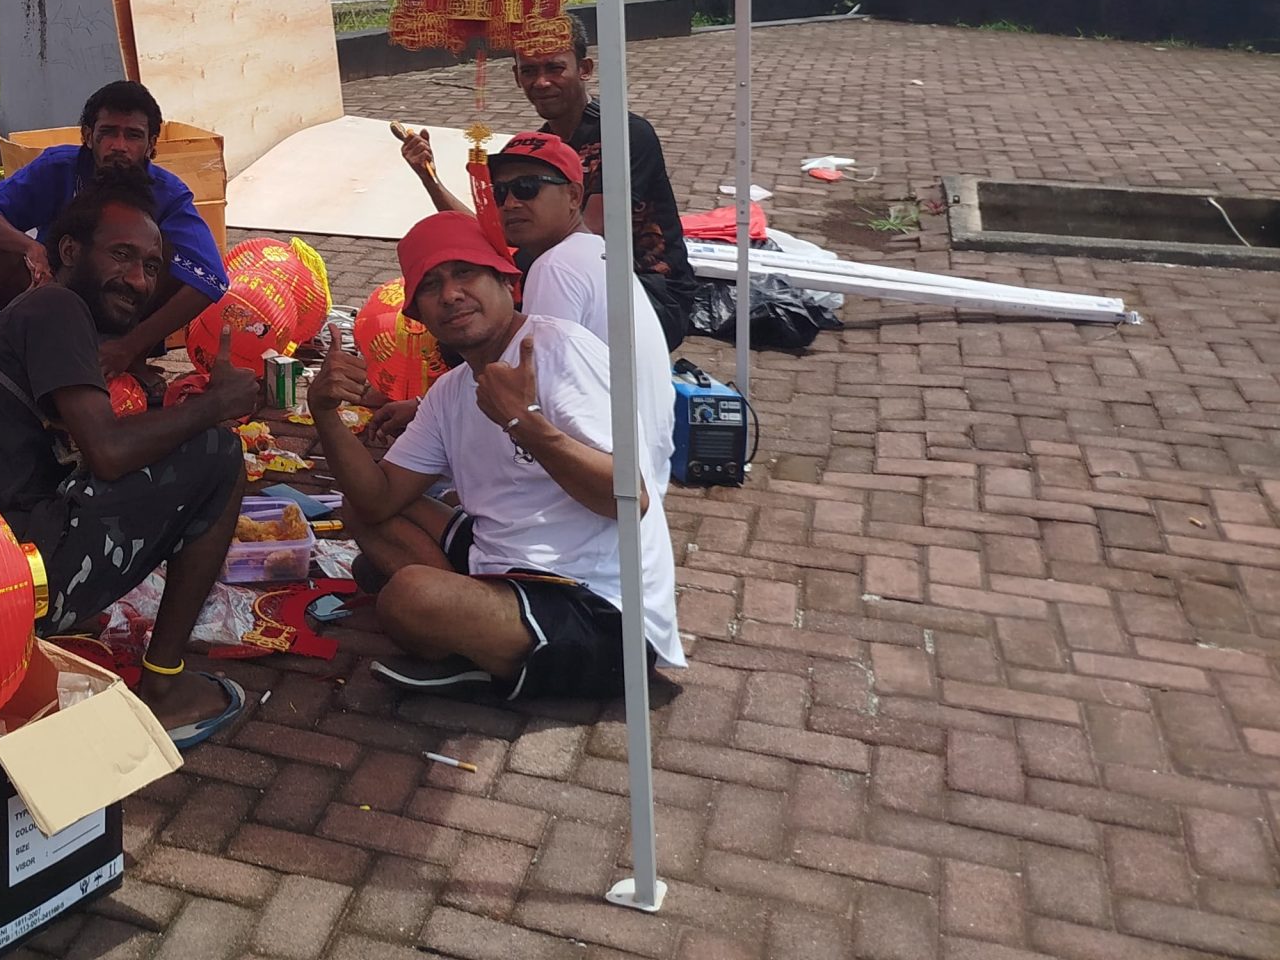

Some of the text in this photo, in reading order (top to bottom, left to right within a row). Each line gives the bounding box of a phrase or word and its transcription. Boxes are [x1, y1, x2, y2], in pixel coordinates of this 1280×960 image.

[14, 808, 30, 821] TYP
[15, 820, 38, 839] COLOU
[15, 842, 30, 856] SIZE
[15, 856, 36, 873] VISOR
